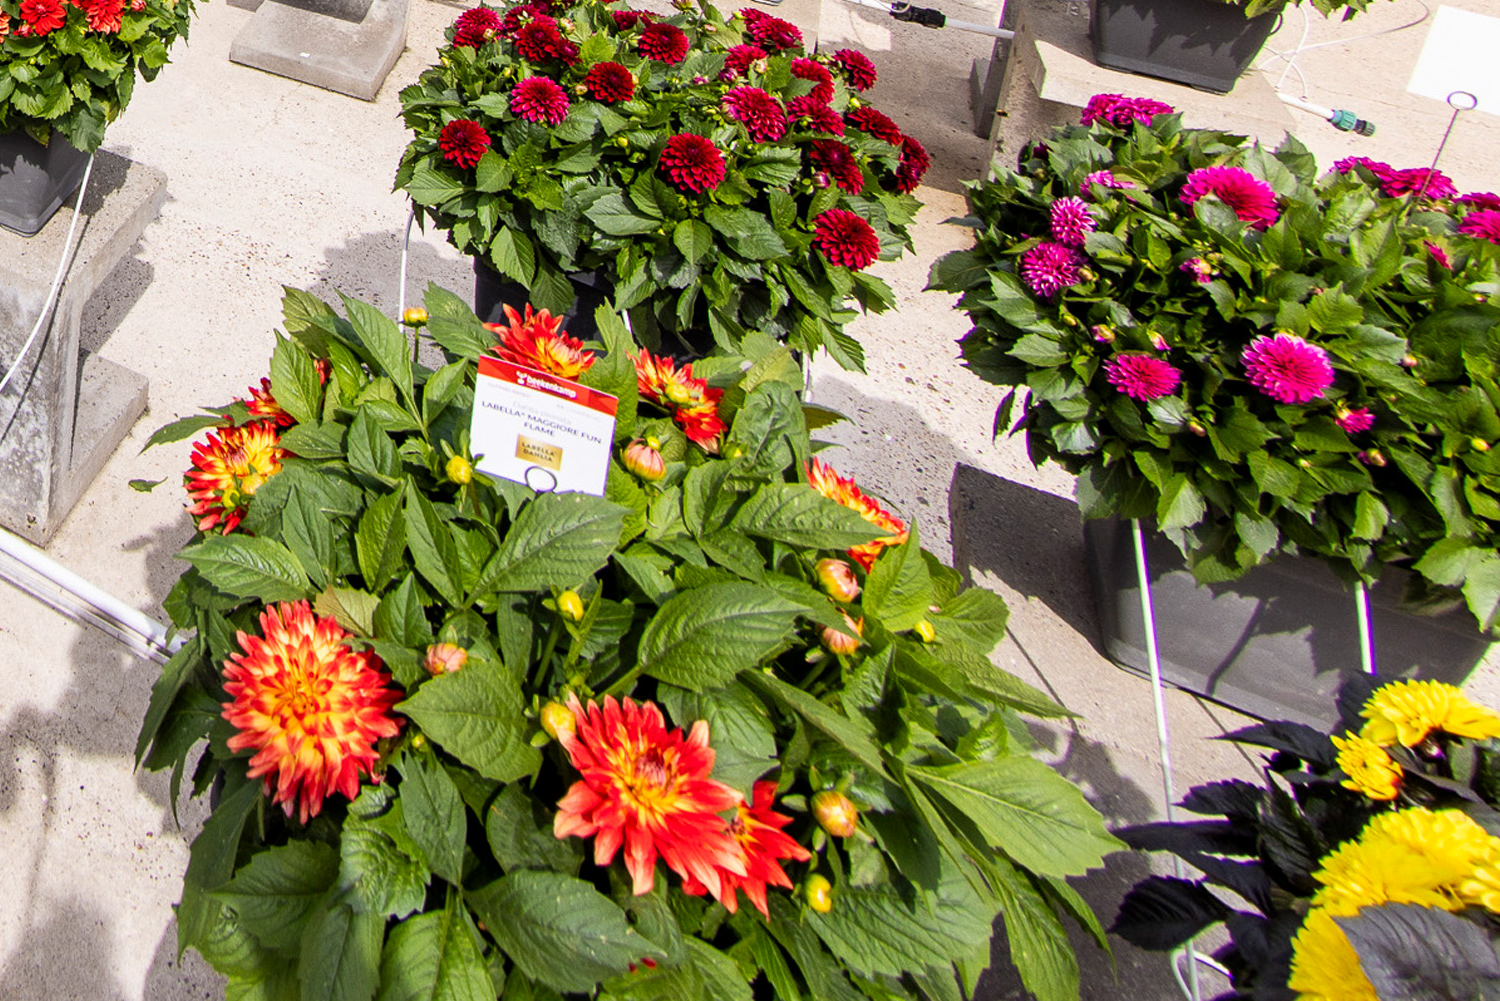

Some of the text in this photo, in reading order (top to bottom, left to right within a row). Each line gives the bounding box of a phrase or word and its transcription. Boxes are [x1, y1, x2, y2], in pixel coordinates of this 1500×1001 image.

[523, 421, 556, 437] FLAME
[528, 414, 579, 436] MAGGIORE
[581, 431, 602, 445] FUN
[522, 448, 553, 463] DAHLIA
